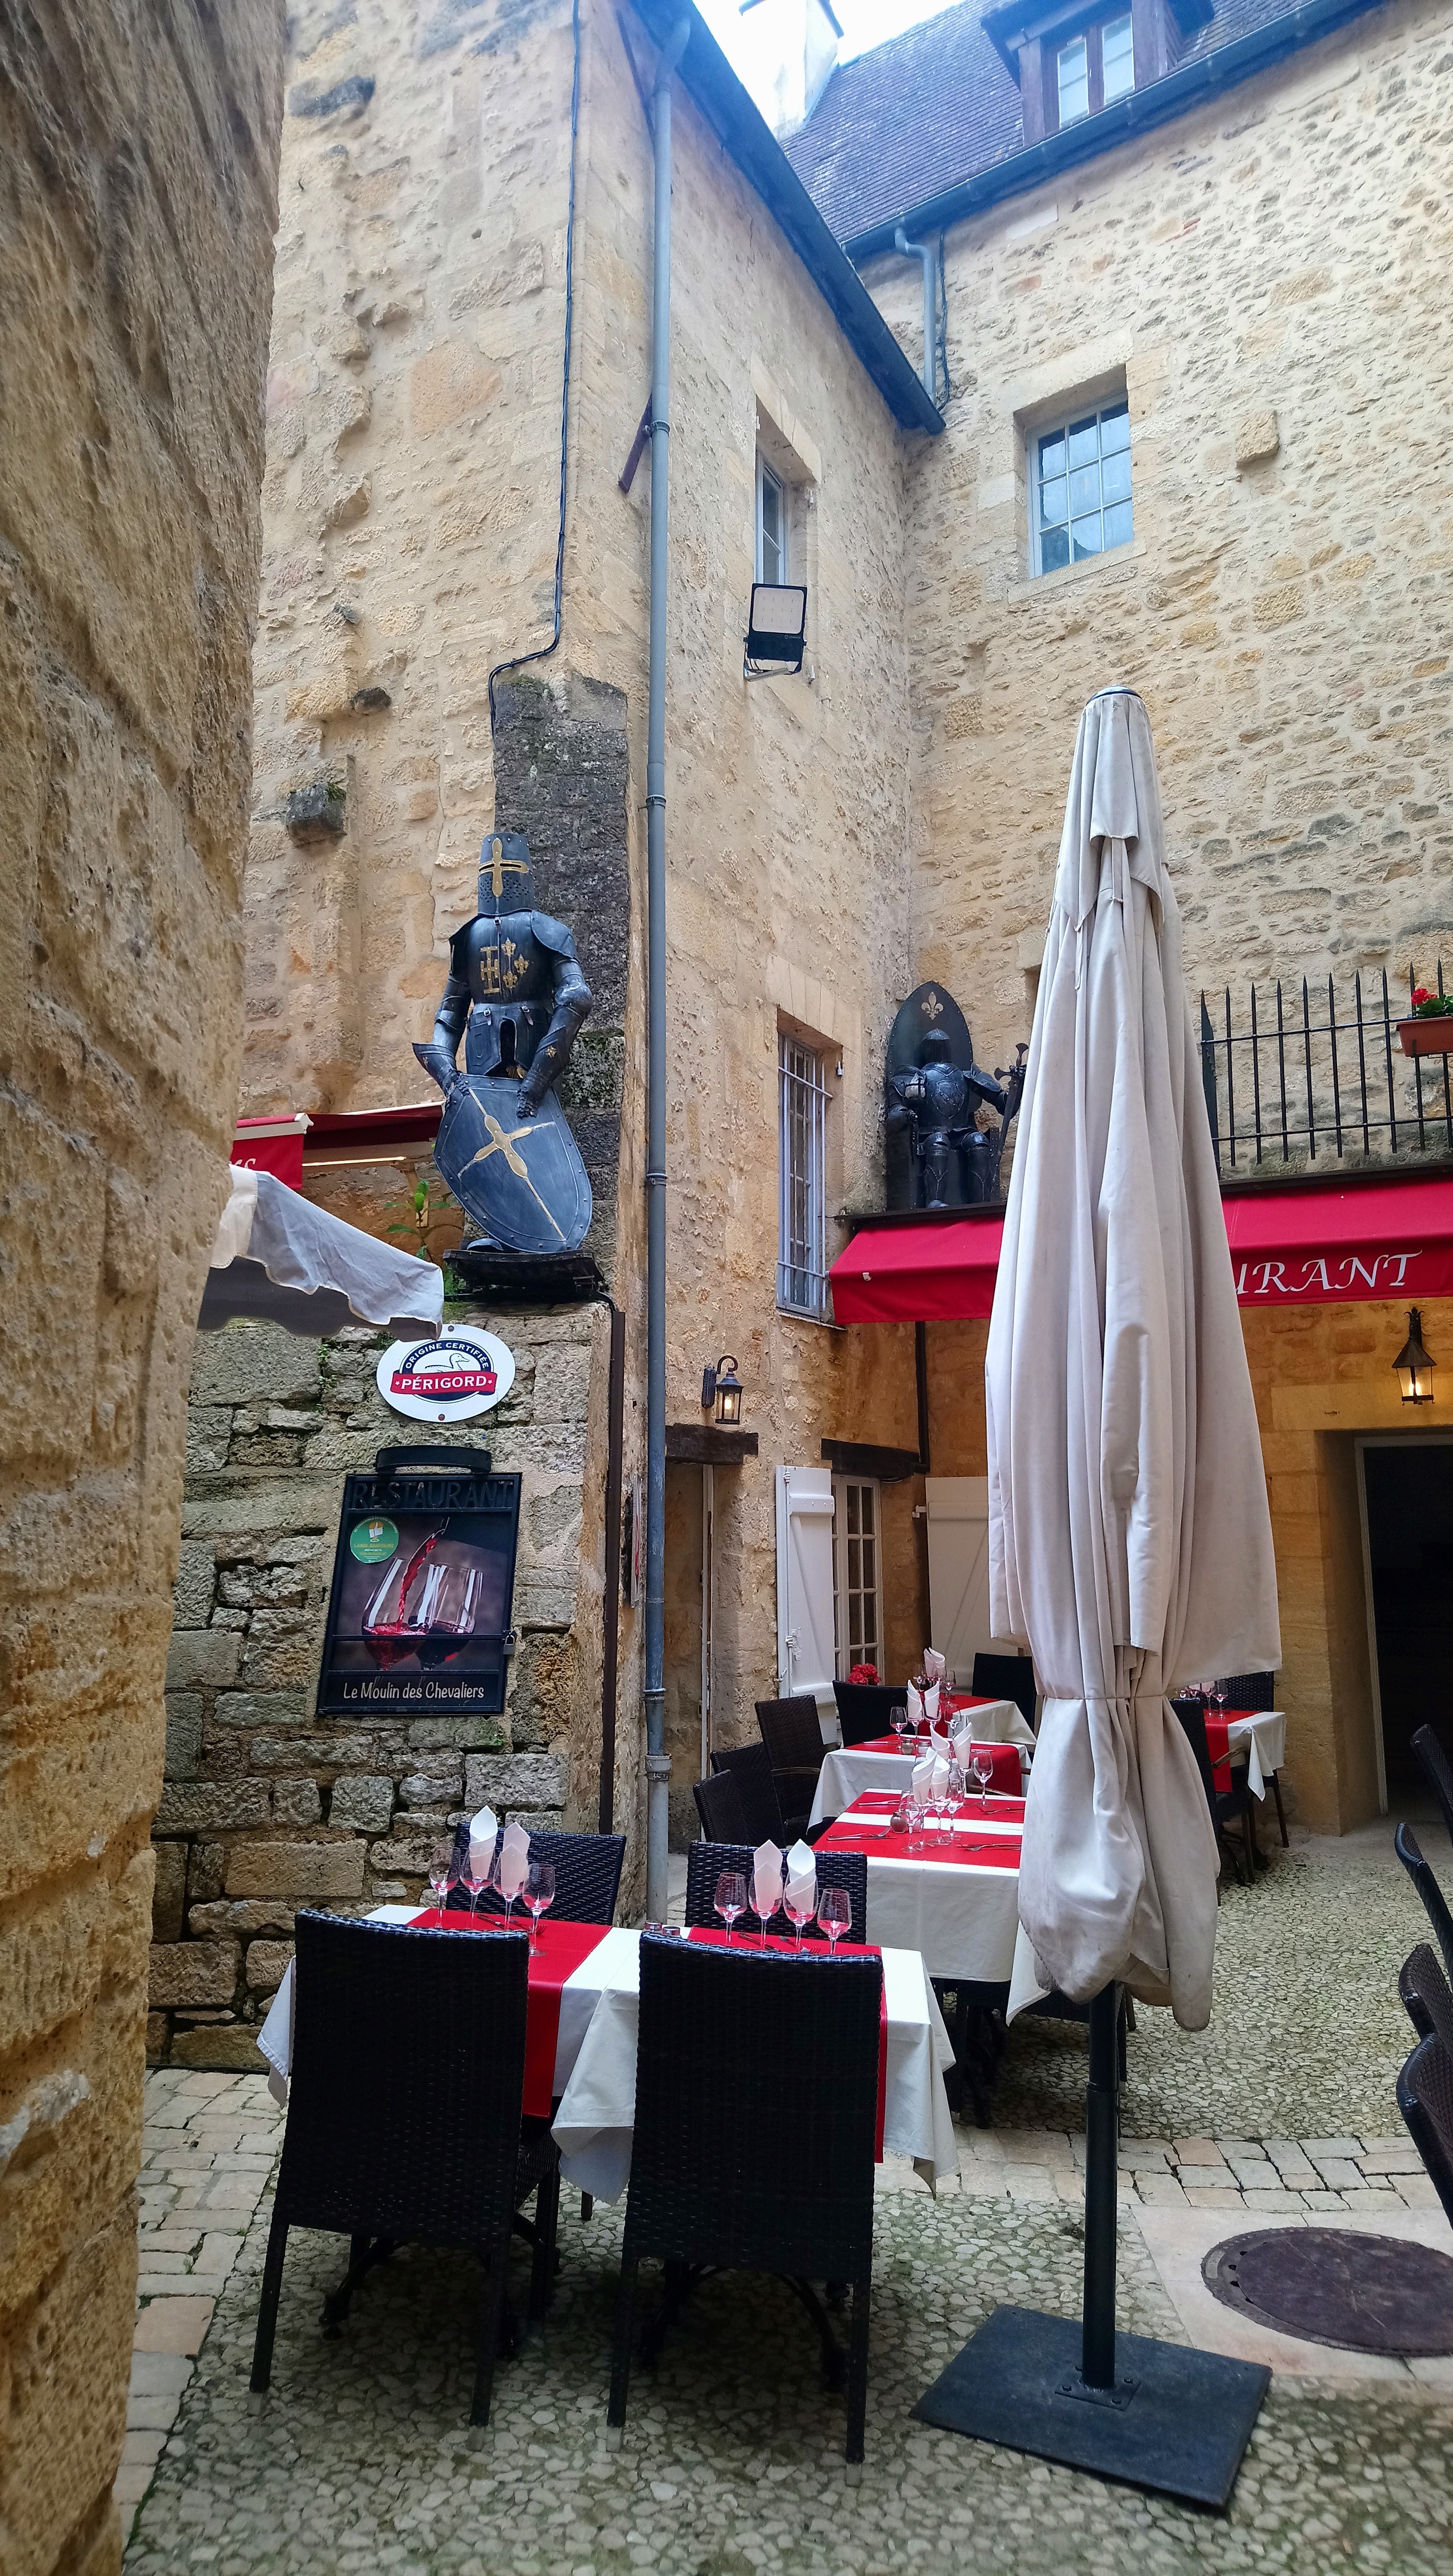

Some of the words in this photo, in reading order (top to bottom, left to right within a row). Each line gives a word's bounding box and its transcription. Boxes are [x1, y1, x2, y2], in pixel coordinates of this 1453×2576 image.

[406, 1342, 442, 1369] ORIGINE
[445, 1342, 489, 1369] CERTIFIÉE
[401, 1375, 487, 1391] PÉRIGORD
[352, 1480, 514, 1508] RESTAURANT
[343, 1682, 358, 1699] Le
[361, 1682, 399, 1699] Moulin
[402, 1682, 422, 1699] des
[425, 1681, 484, 1699] Chevaliers
